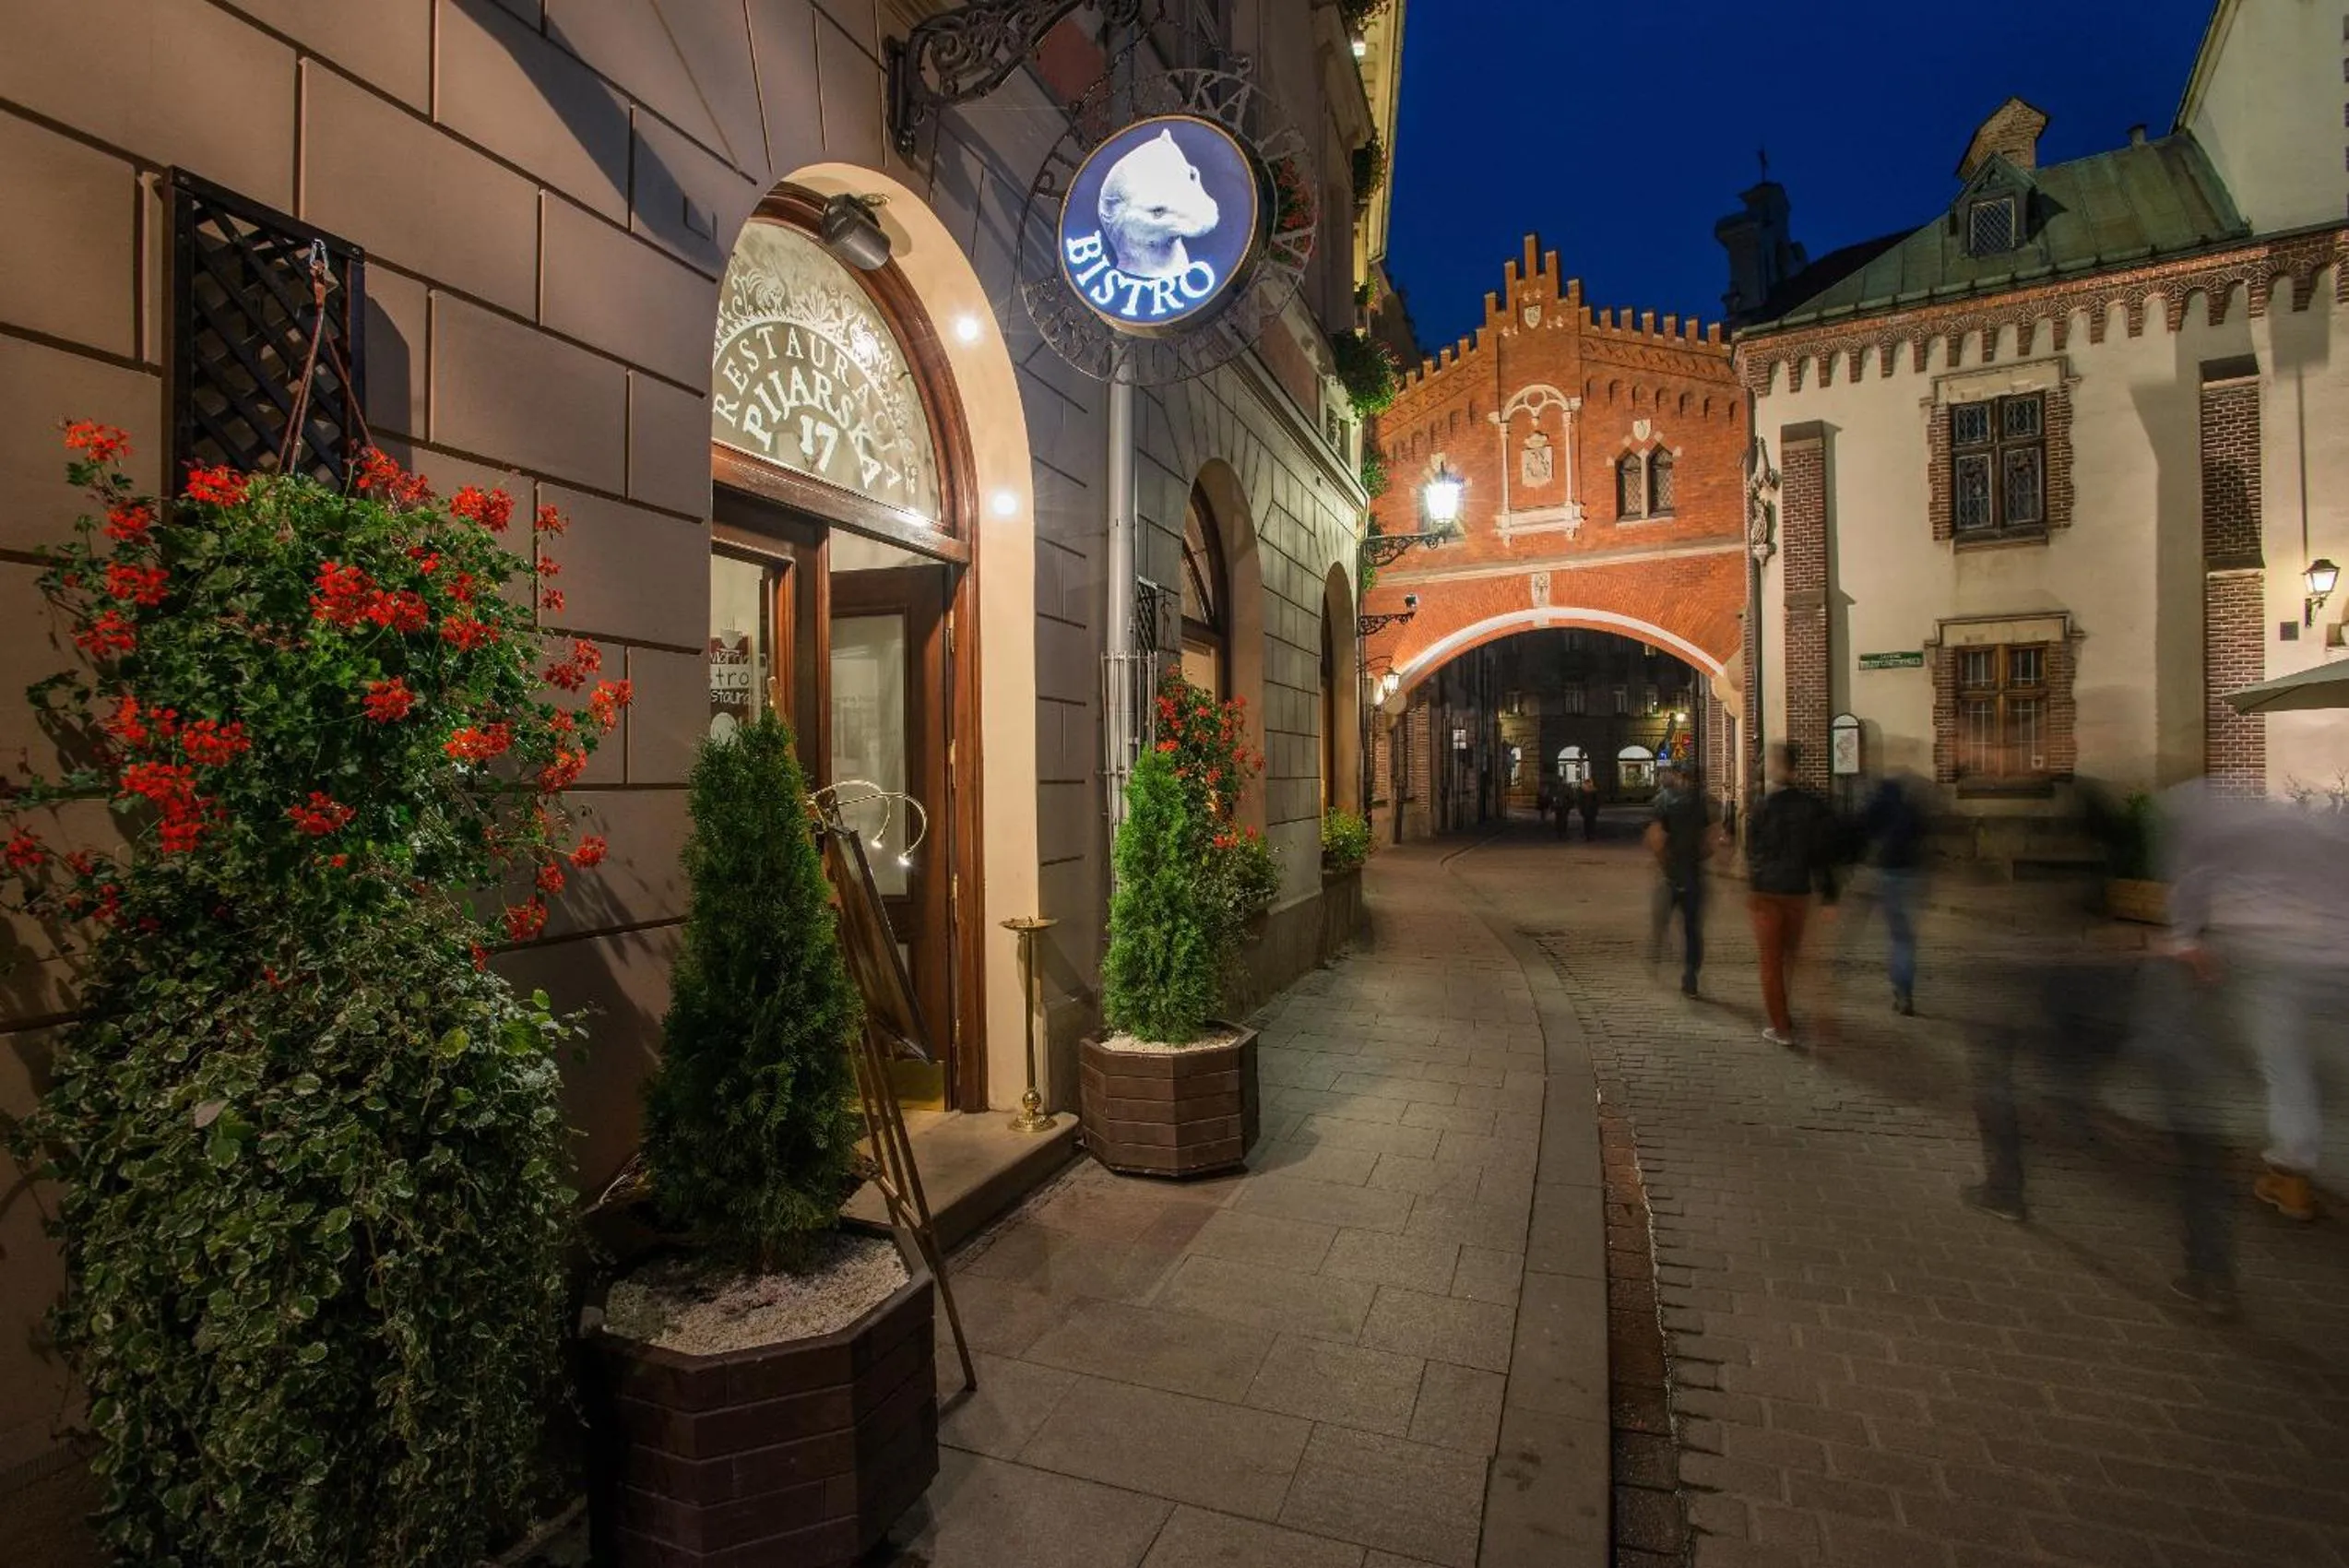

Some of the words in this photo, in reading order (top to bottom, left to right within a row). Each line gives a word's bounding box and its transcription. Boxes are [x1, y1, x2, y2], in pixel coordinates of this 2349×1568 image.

[1066, 230, 1215, 315] BISTRO
[712, 326, 902, 490] RESTAURACJA
[742, 365, 882, 489] PIJARSKA
[800, 415, 838, 473] 17
[715, 667, 750, 687] tro
